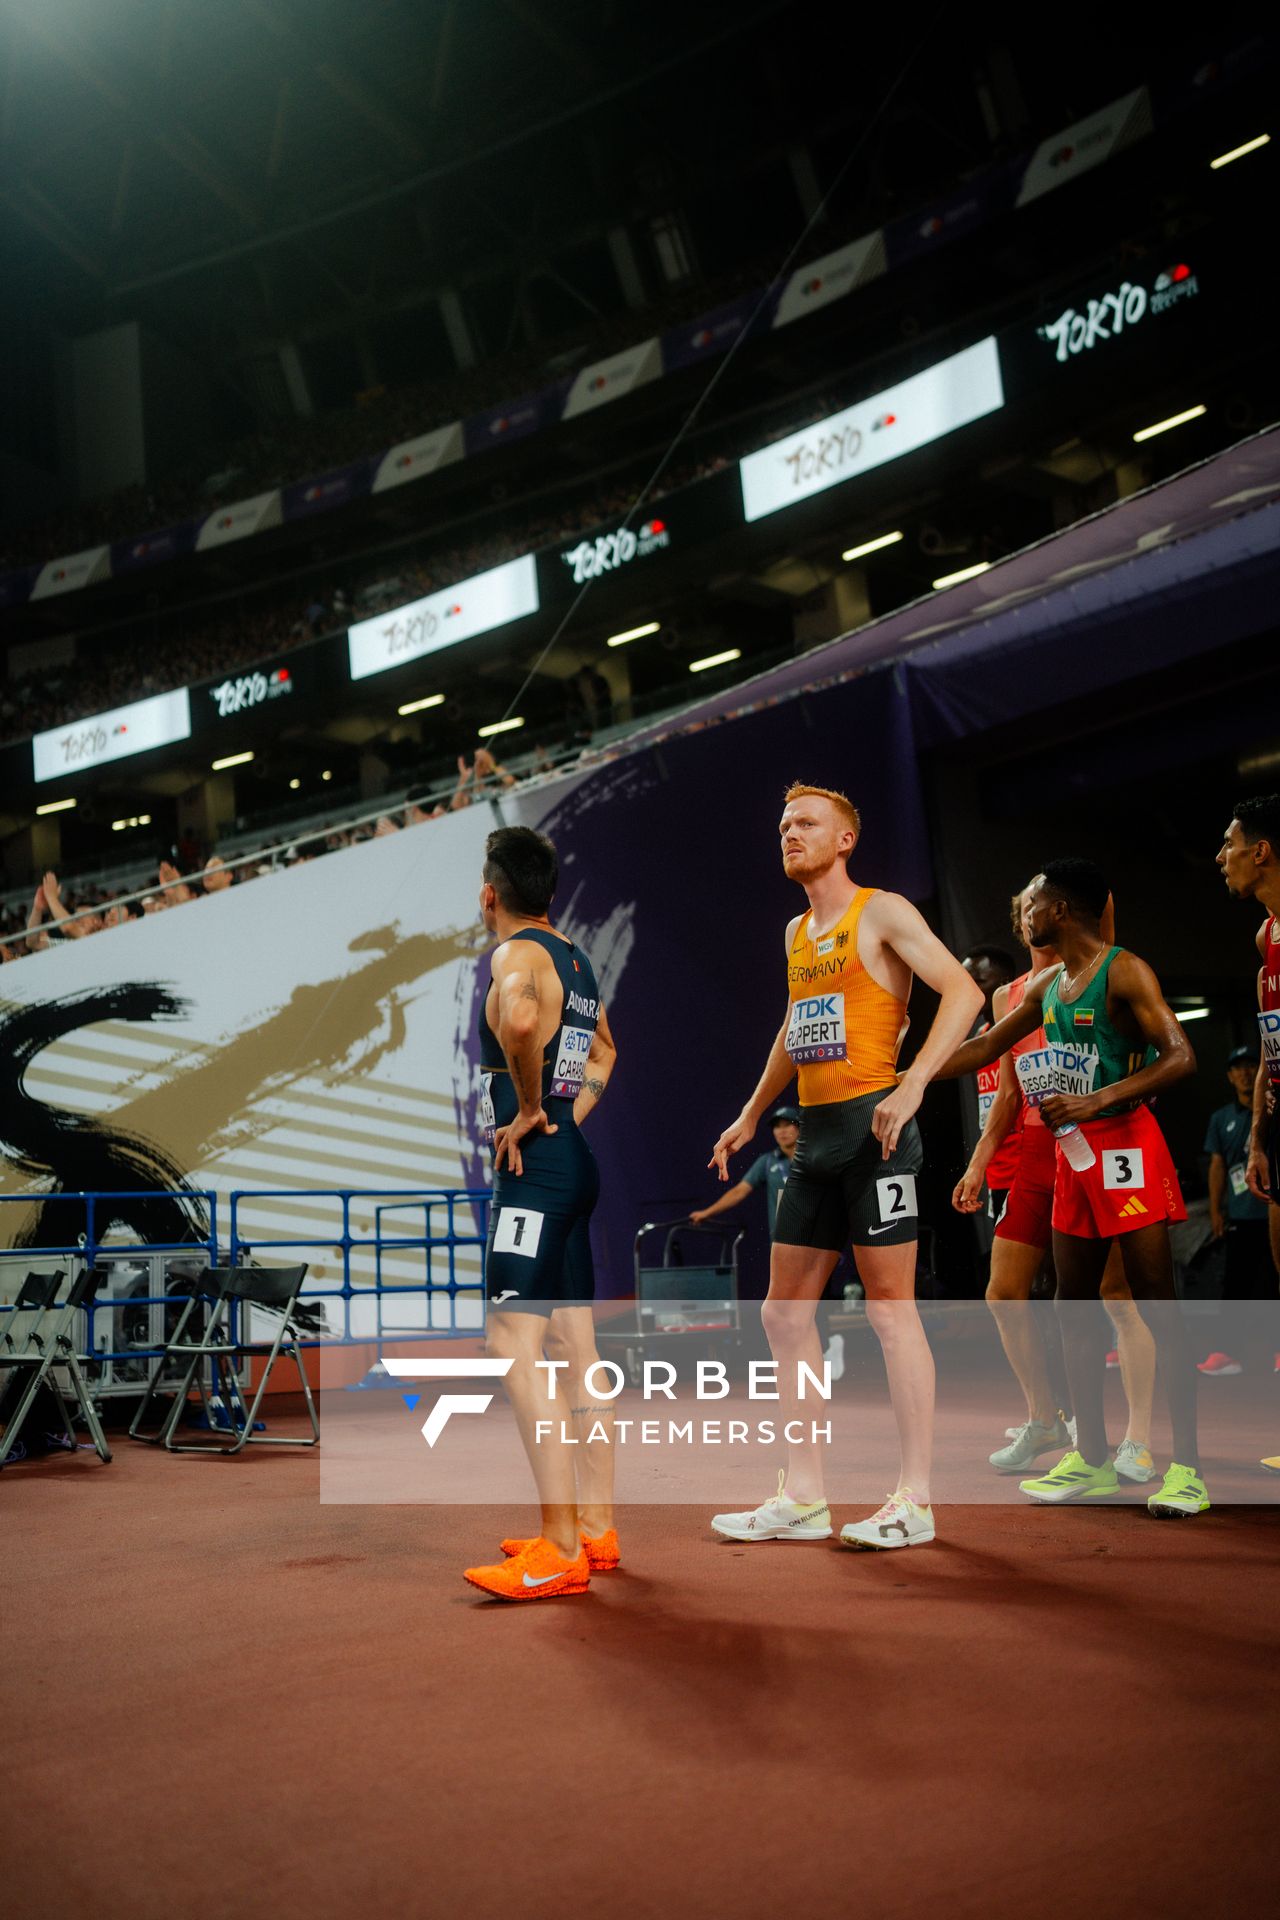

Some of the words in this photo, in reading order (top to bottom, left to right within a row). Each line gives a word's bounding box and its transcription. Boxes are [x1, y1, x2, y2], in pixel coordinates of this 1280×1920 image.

[1044, 281, 1147, 363] TOKYO
[784, 426, 862, 485] TOKYO
[565, 527, 638, 584] TOKYO
[382, 611, 439, 655] TOKYO
[213, 671, 268, 718] TOKYO
[796, 996, 838, 1020] TDK
[787, 1021, 841, 1048] RUPPERT
[1052, 1048, 1091, 1075] TDK
[1114, 1155, 1133, 1184] 3
[886, 1182, 907, 1214] 2
[513, 1216, 526, 1247] 1
